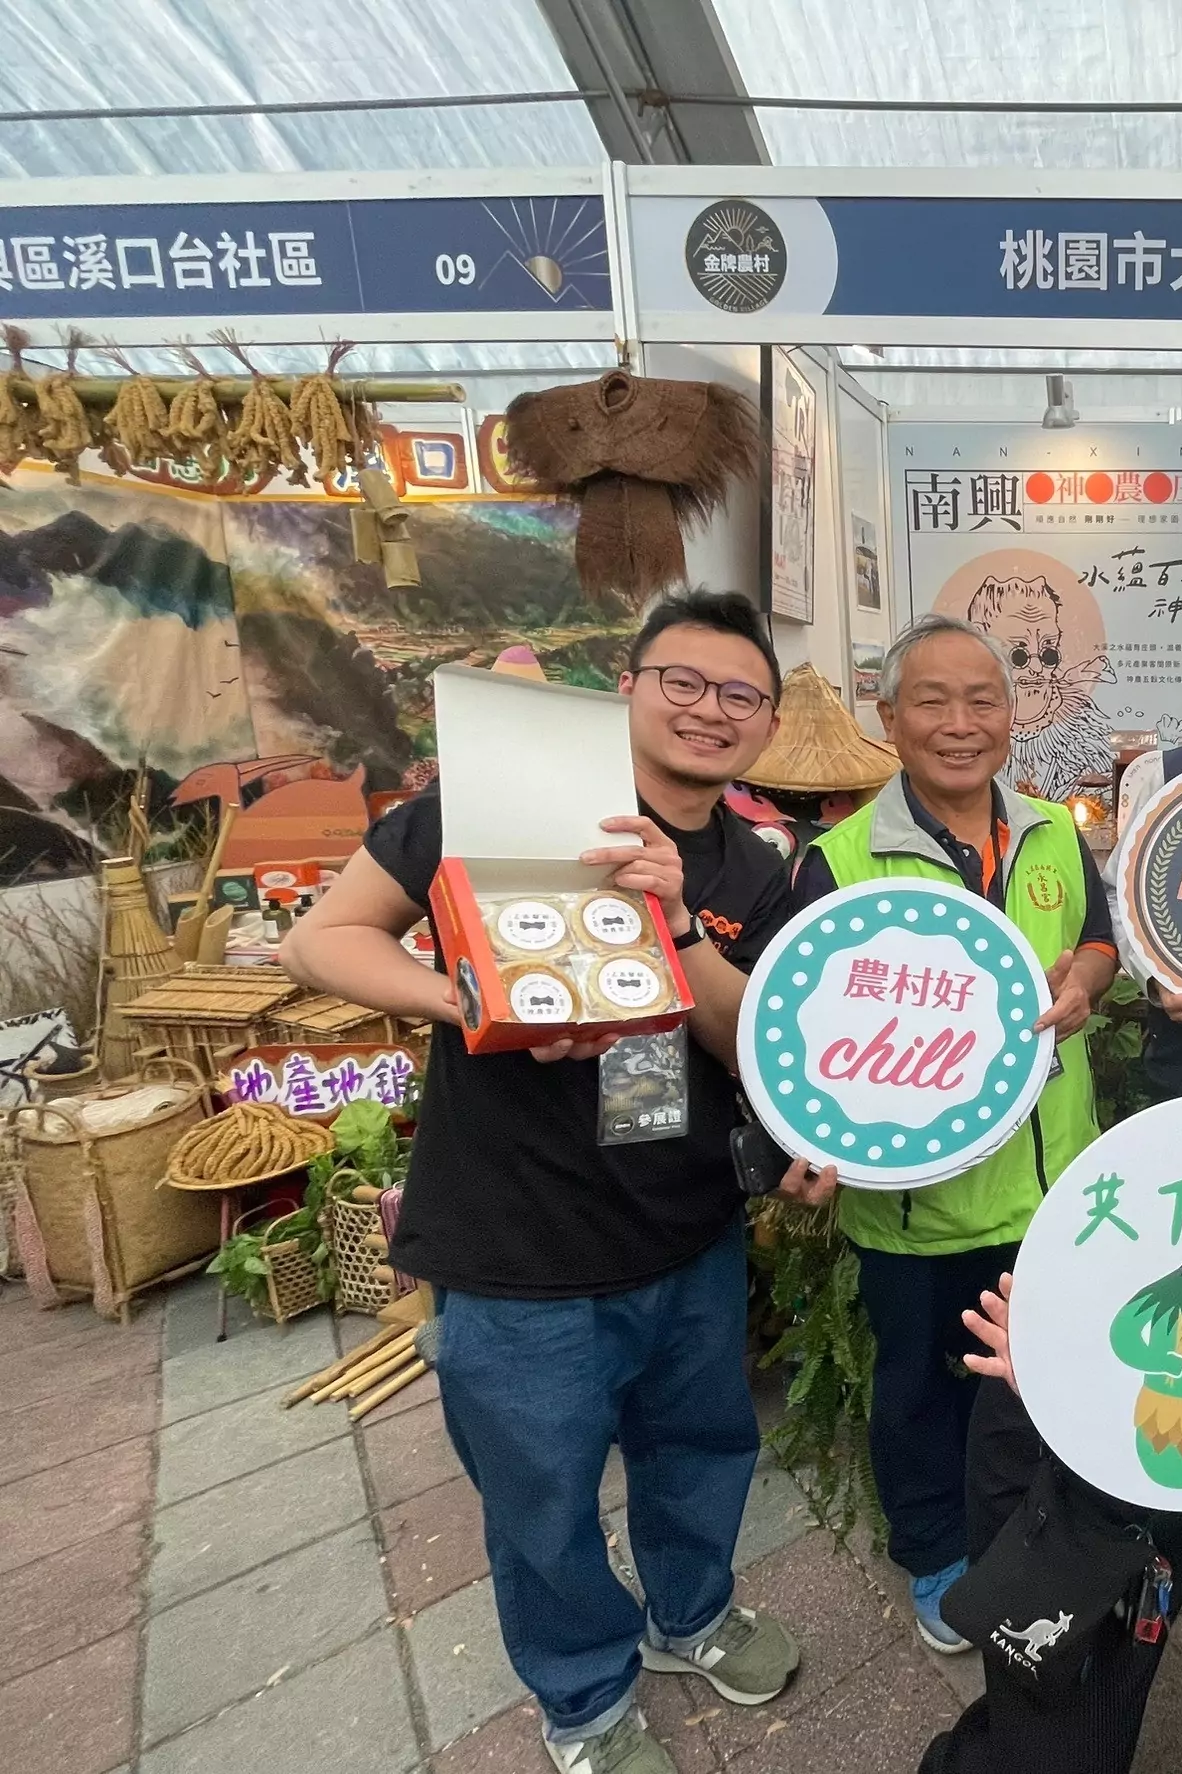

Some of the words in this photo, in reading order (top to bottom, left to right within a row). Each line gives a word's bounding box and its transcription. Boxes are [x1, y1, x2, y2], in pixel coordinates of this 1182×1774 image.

[435, 253, 477, 286] 09
[703, 253, 770, 273] 金牌農村
[906, 472, 1023, 532] 南興
[843, 957, 977, 1013] 農村好
[818, 1015, 977, 1091] chill
[233, 1054, 411, 1112] 地產地銷
[989, 1630, 1039, 1680] KANGOL
